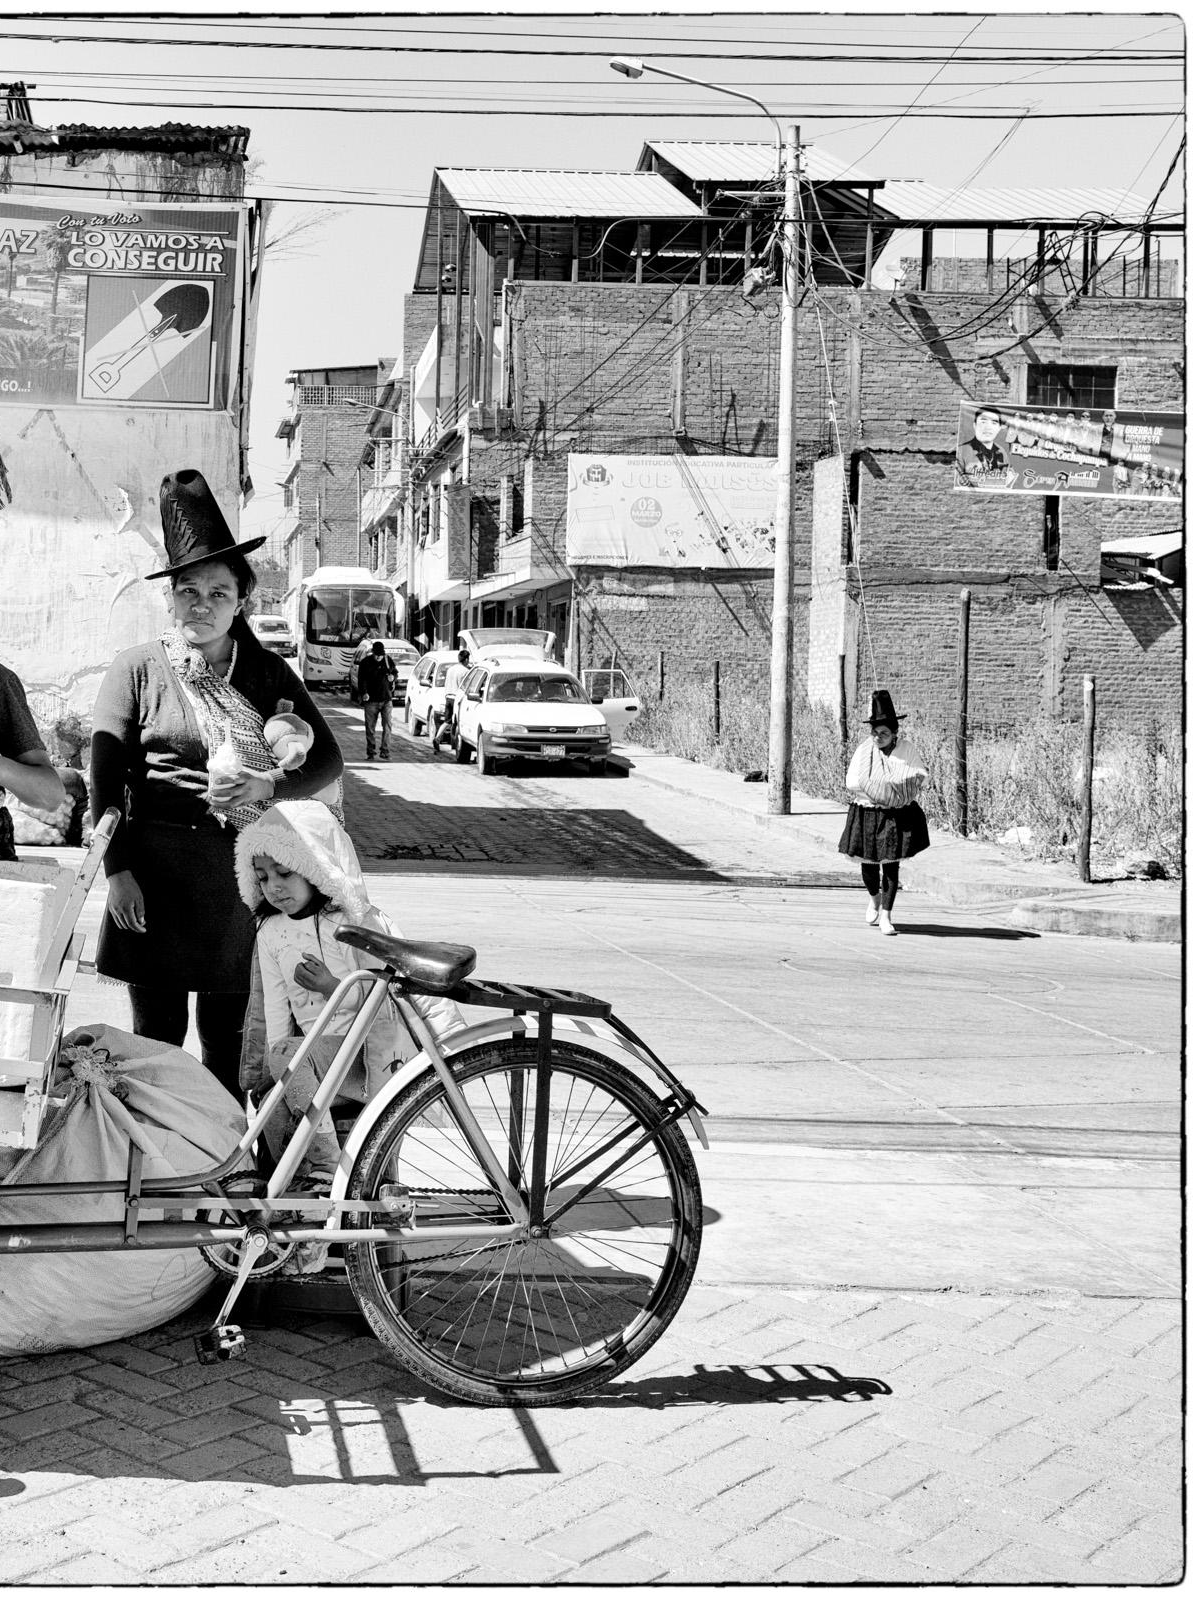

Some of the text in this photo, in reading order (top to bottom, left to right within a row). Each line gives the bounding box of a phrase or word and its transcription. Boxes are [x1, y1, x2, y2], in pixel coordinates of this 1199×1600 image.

[56, 212, 143, 230] Con tu Voto
[70, 231, 225, 250] LO VAMOS A
[67, 248, 224, 273] CONSEGUIR
[627, 459, 679, 467] INSTITUCIÓ
[638, 497, 656, 511] 02
